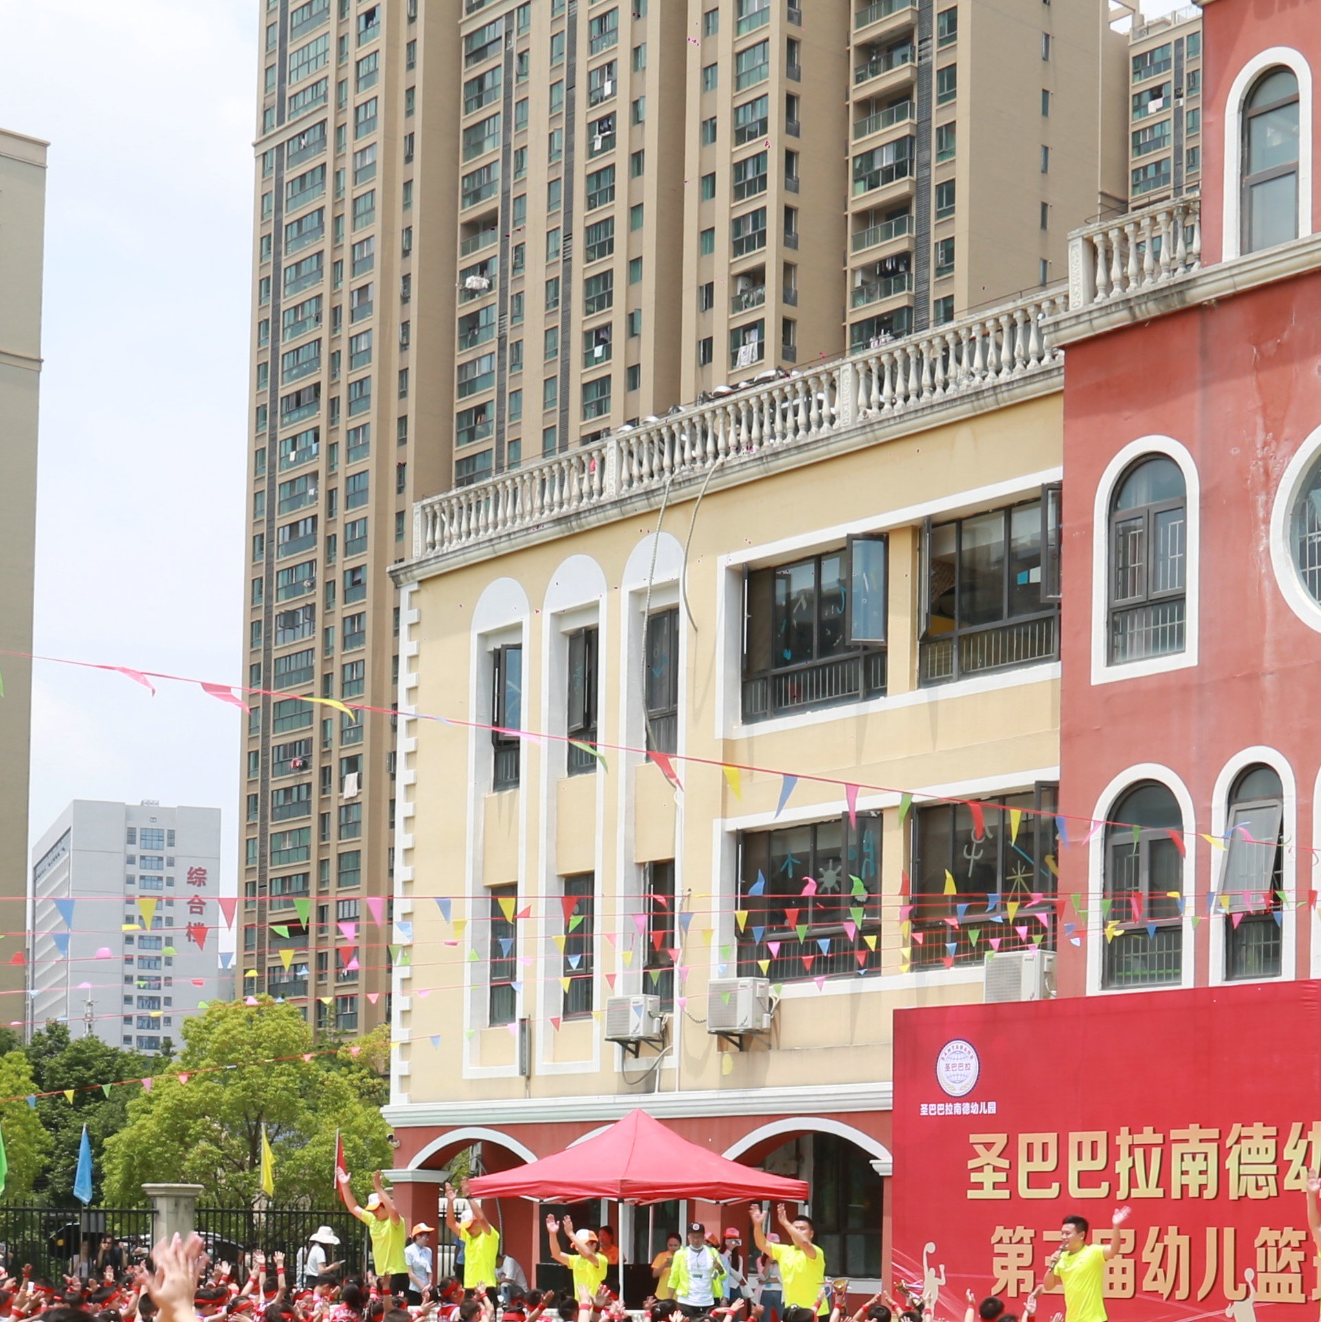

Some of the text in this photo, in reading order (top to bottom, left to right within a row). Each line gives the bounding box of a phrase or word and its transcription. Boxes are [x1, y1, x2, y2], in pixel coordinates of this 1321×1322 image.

[919, 1101, 997, 1116] 圣巴巴拉南德幼儿园
